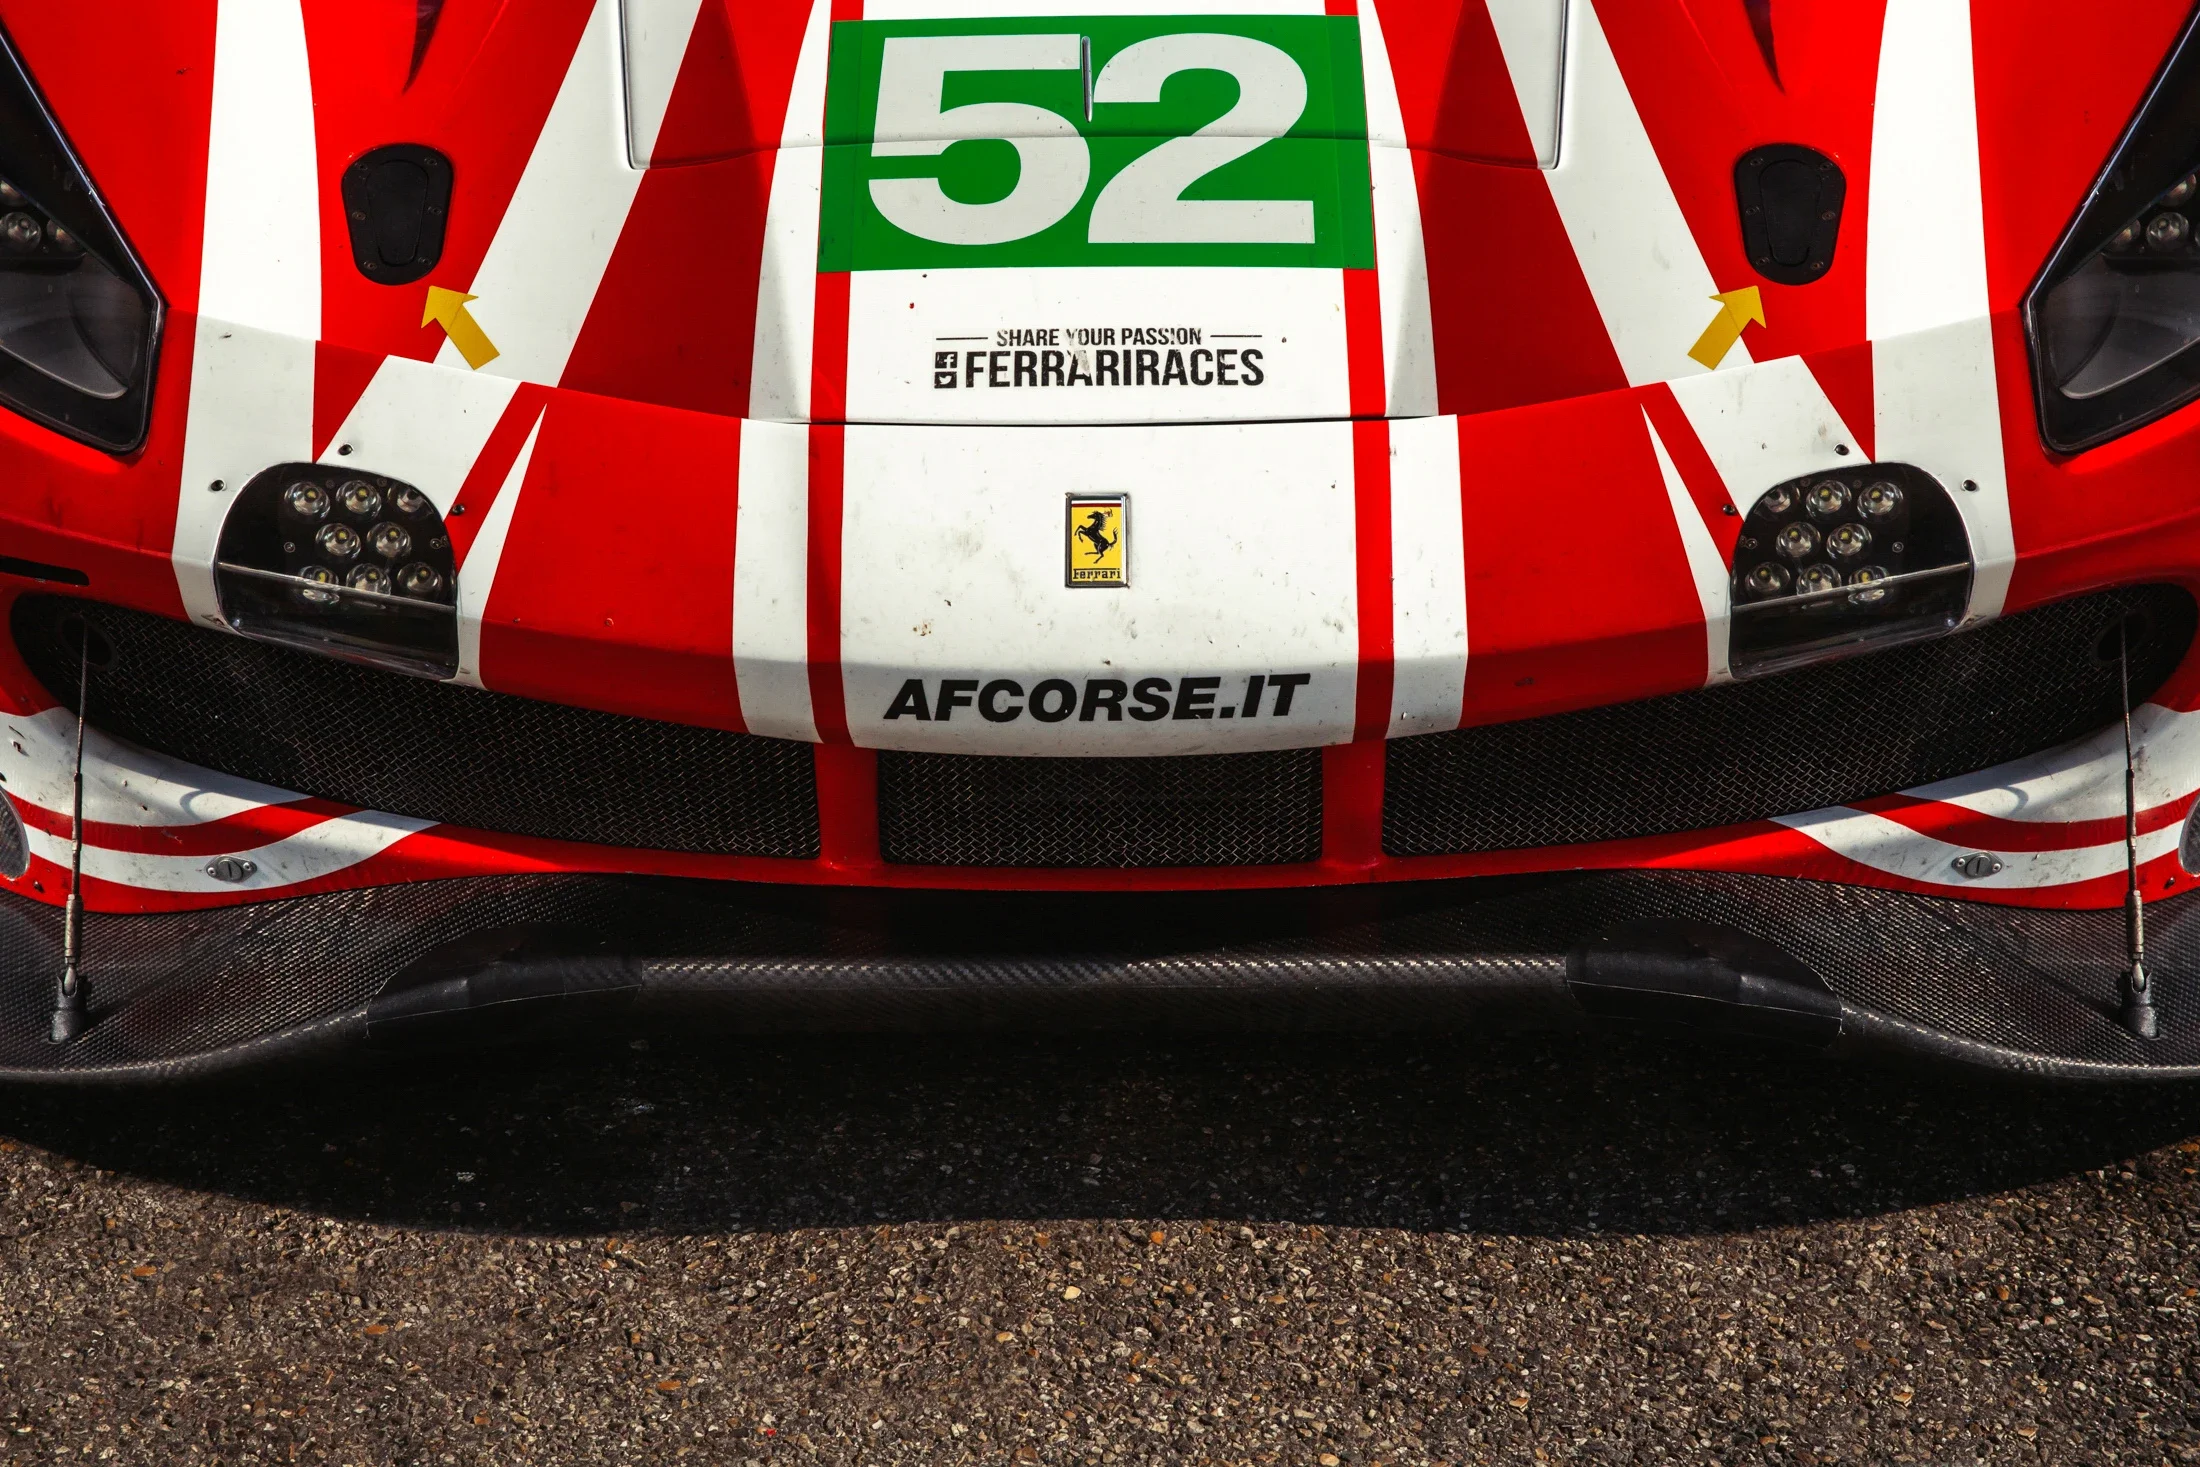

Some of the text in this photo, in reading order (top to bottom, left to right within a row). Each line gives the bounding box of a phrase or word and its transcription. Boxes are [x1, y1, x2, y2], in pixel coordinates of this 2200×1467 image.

[868, 33, 1316, 245] 52
[996, 328, 1060, 347] SHARE
[1120, 327, 1202, 346] PASSION
[965, 348, 1265, 388] FERRARIRACES
[1072, 567, 1121, 580] Ferrari
[883, 673, 1311, 723] AFCORSE.IT
